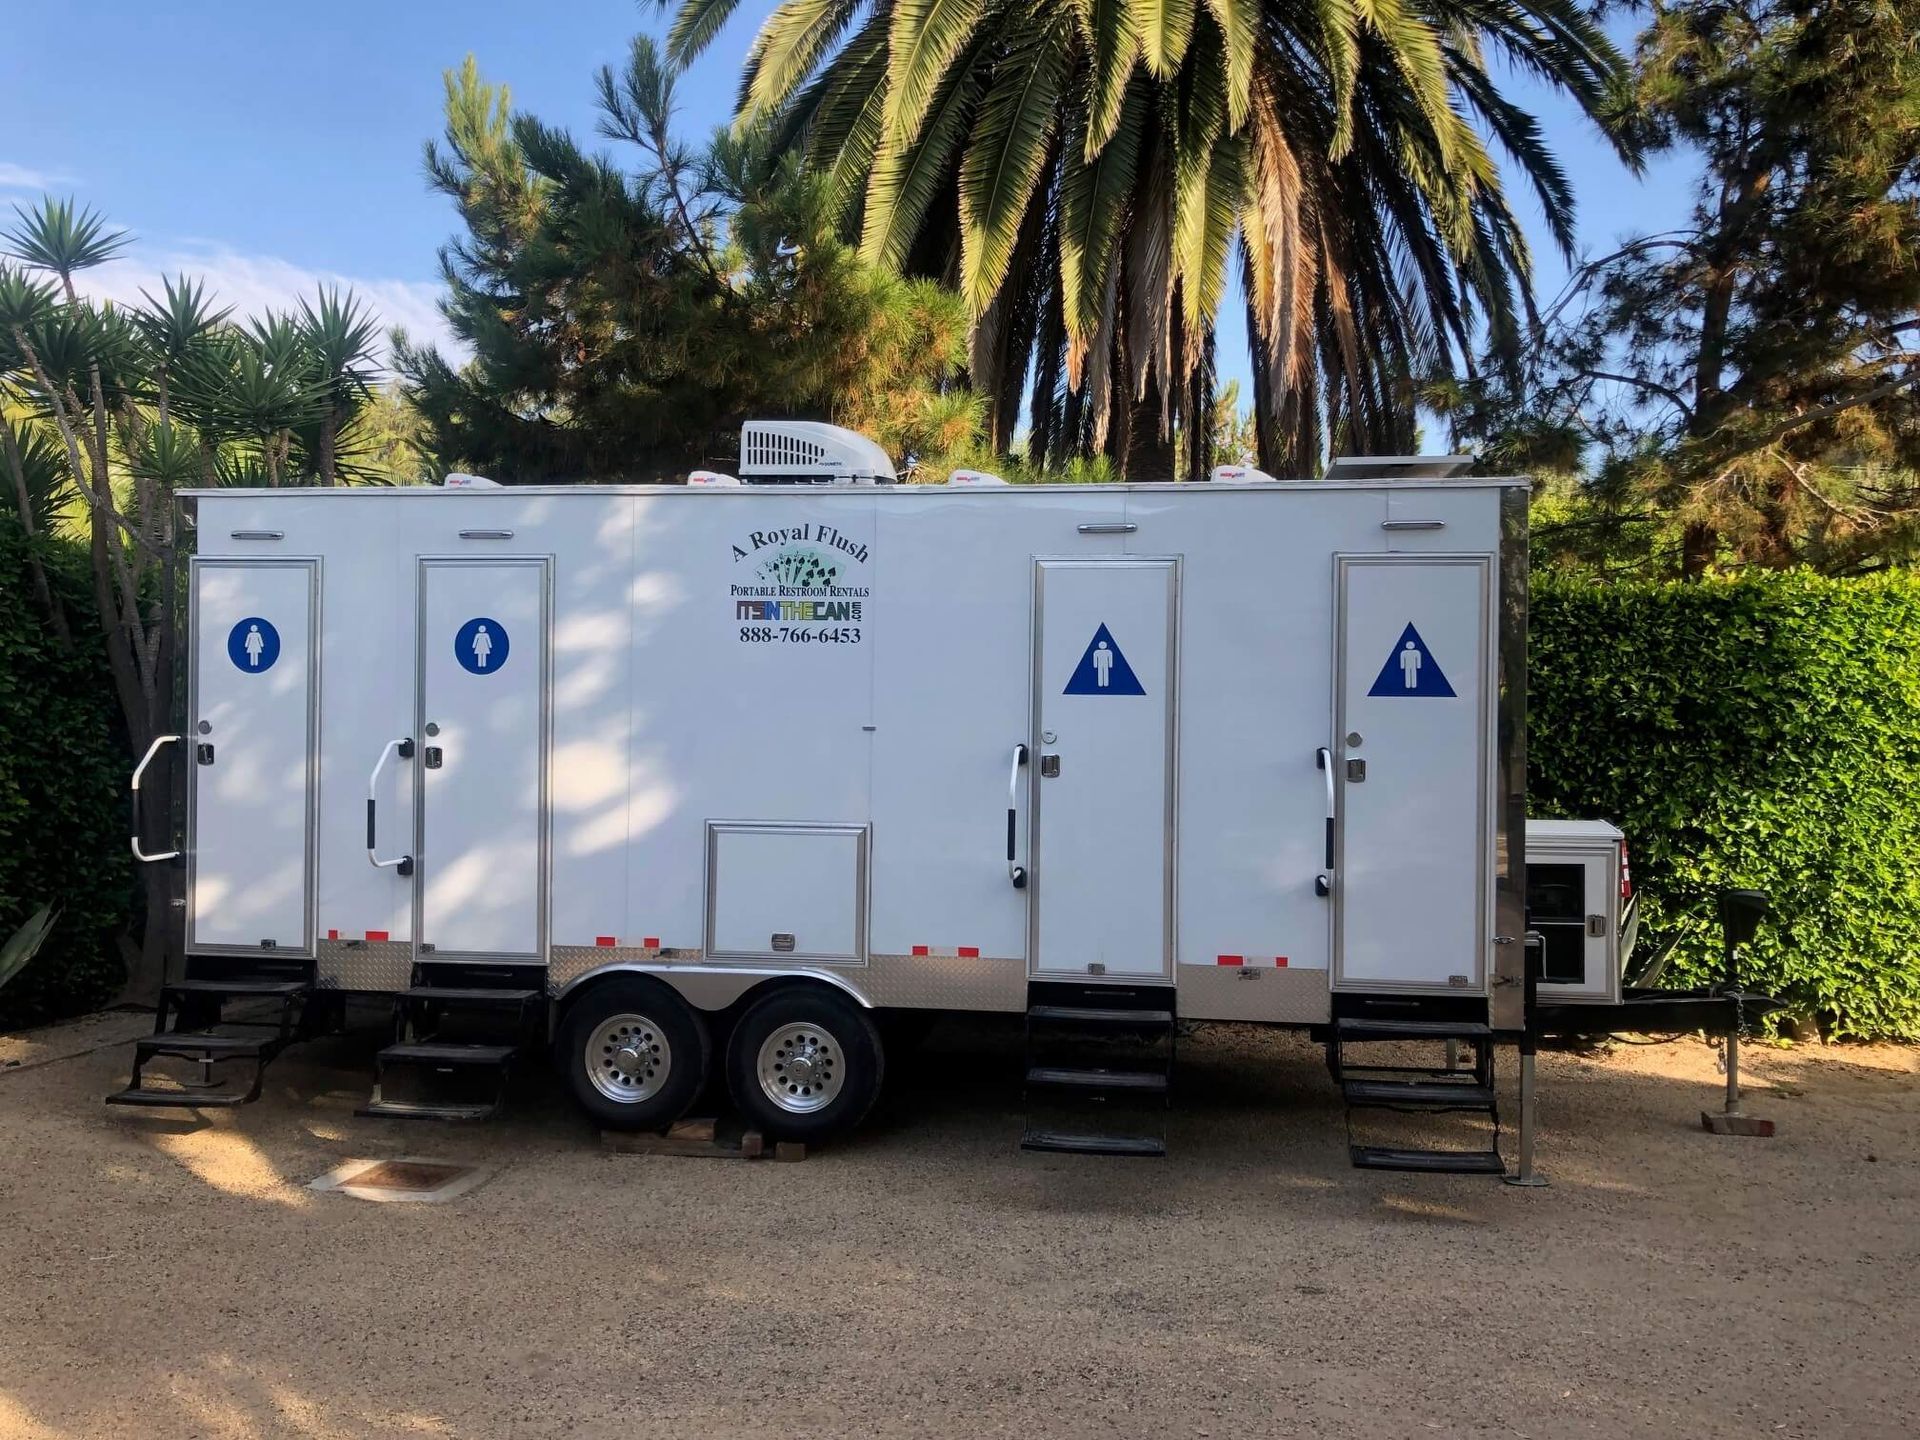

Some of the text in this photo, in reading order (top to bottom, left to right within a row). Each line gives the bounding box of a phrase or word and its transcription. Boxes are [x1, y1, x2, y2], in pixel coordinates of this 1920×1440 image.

[731, 523, 870, 564] A Royal Flush
[730, 584, 870, 598] PORTABLE RESTROOM RENTALS
[740, 627, 861, 644] 888-766-6453
